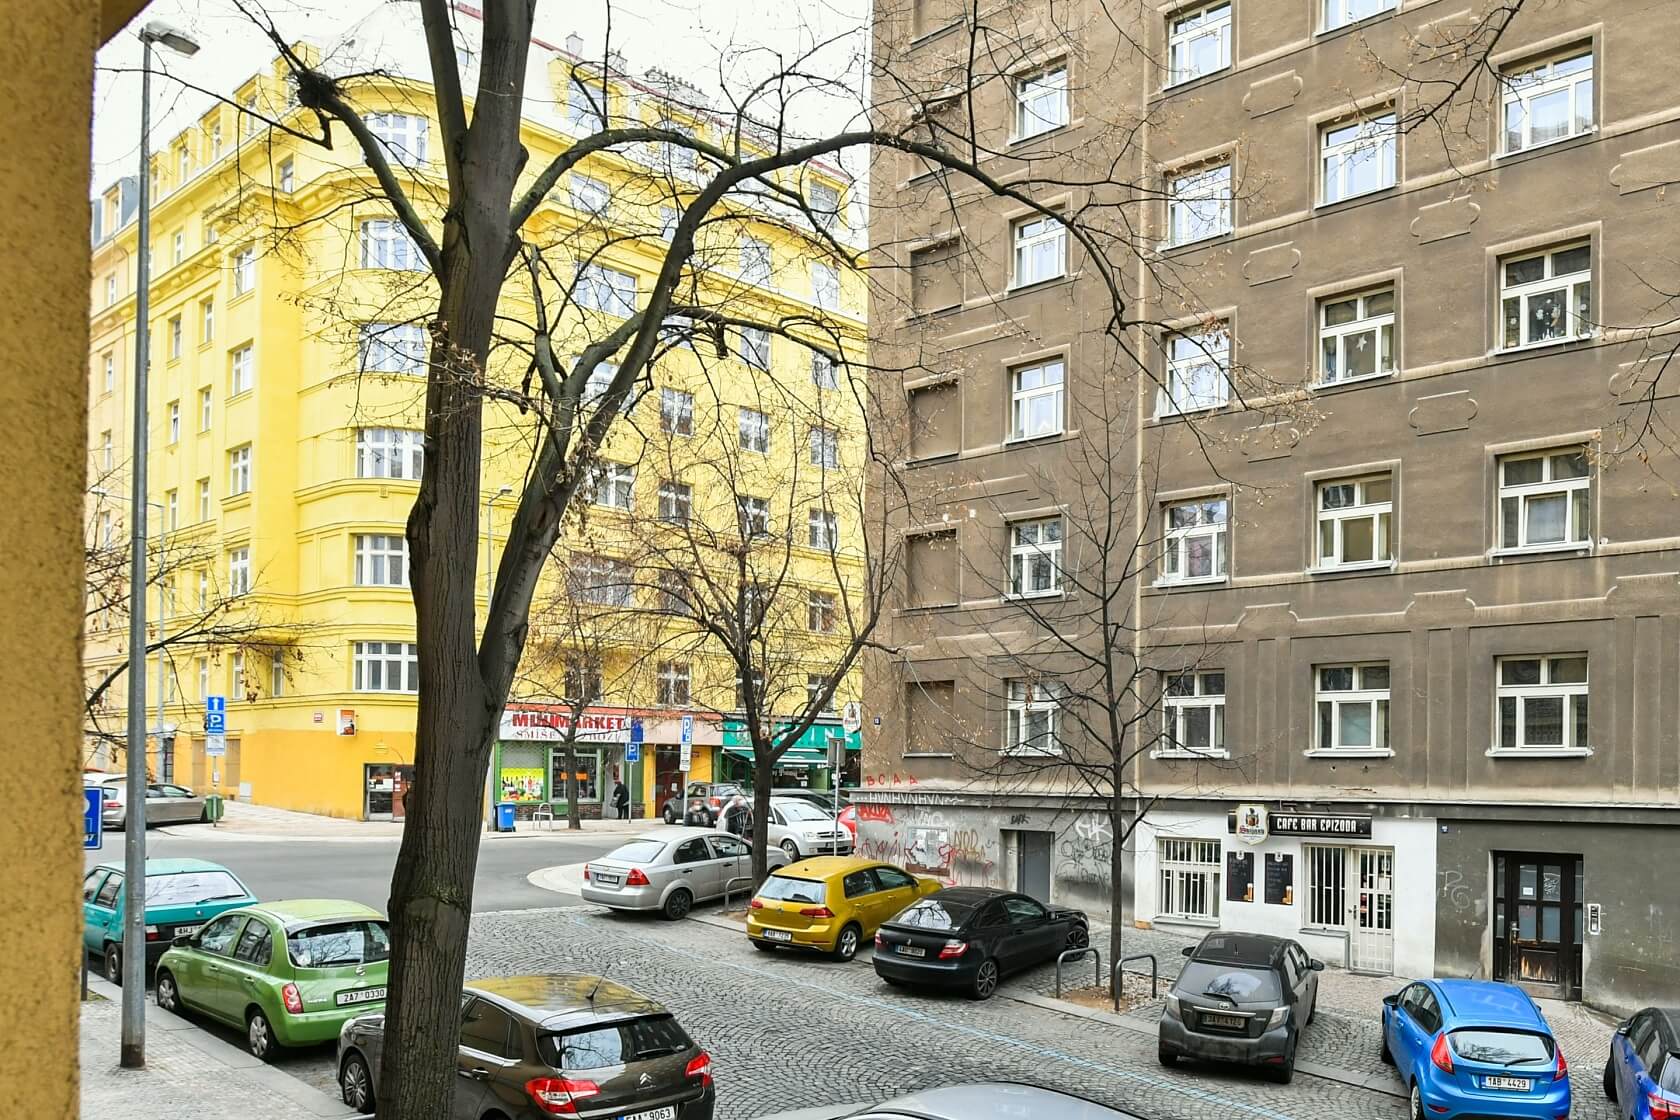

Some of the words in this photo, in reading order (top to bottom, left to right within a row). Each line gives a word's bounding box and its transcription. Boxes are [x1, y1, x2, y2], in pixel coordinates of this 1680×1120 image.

[1277, 817, 1298, 830] CAFE
[1301, 818, 1317, 831] BAR
[1320, 819, 1357, 833] EPIZODA
[343, 992, 359, 1003] 2A7
[364, 989, 385, 999] 0330
[1488, 1077, 1502, 1086] 1AB
[1507, 1079, 1526, 1088] 4429
[649, 1108, 671, 1120] 9063
